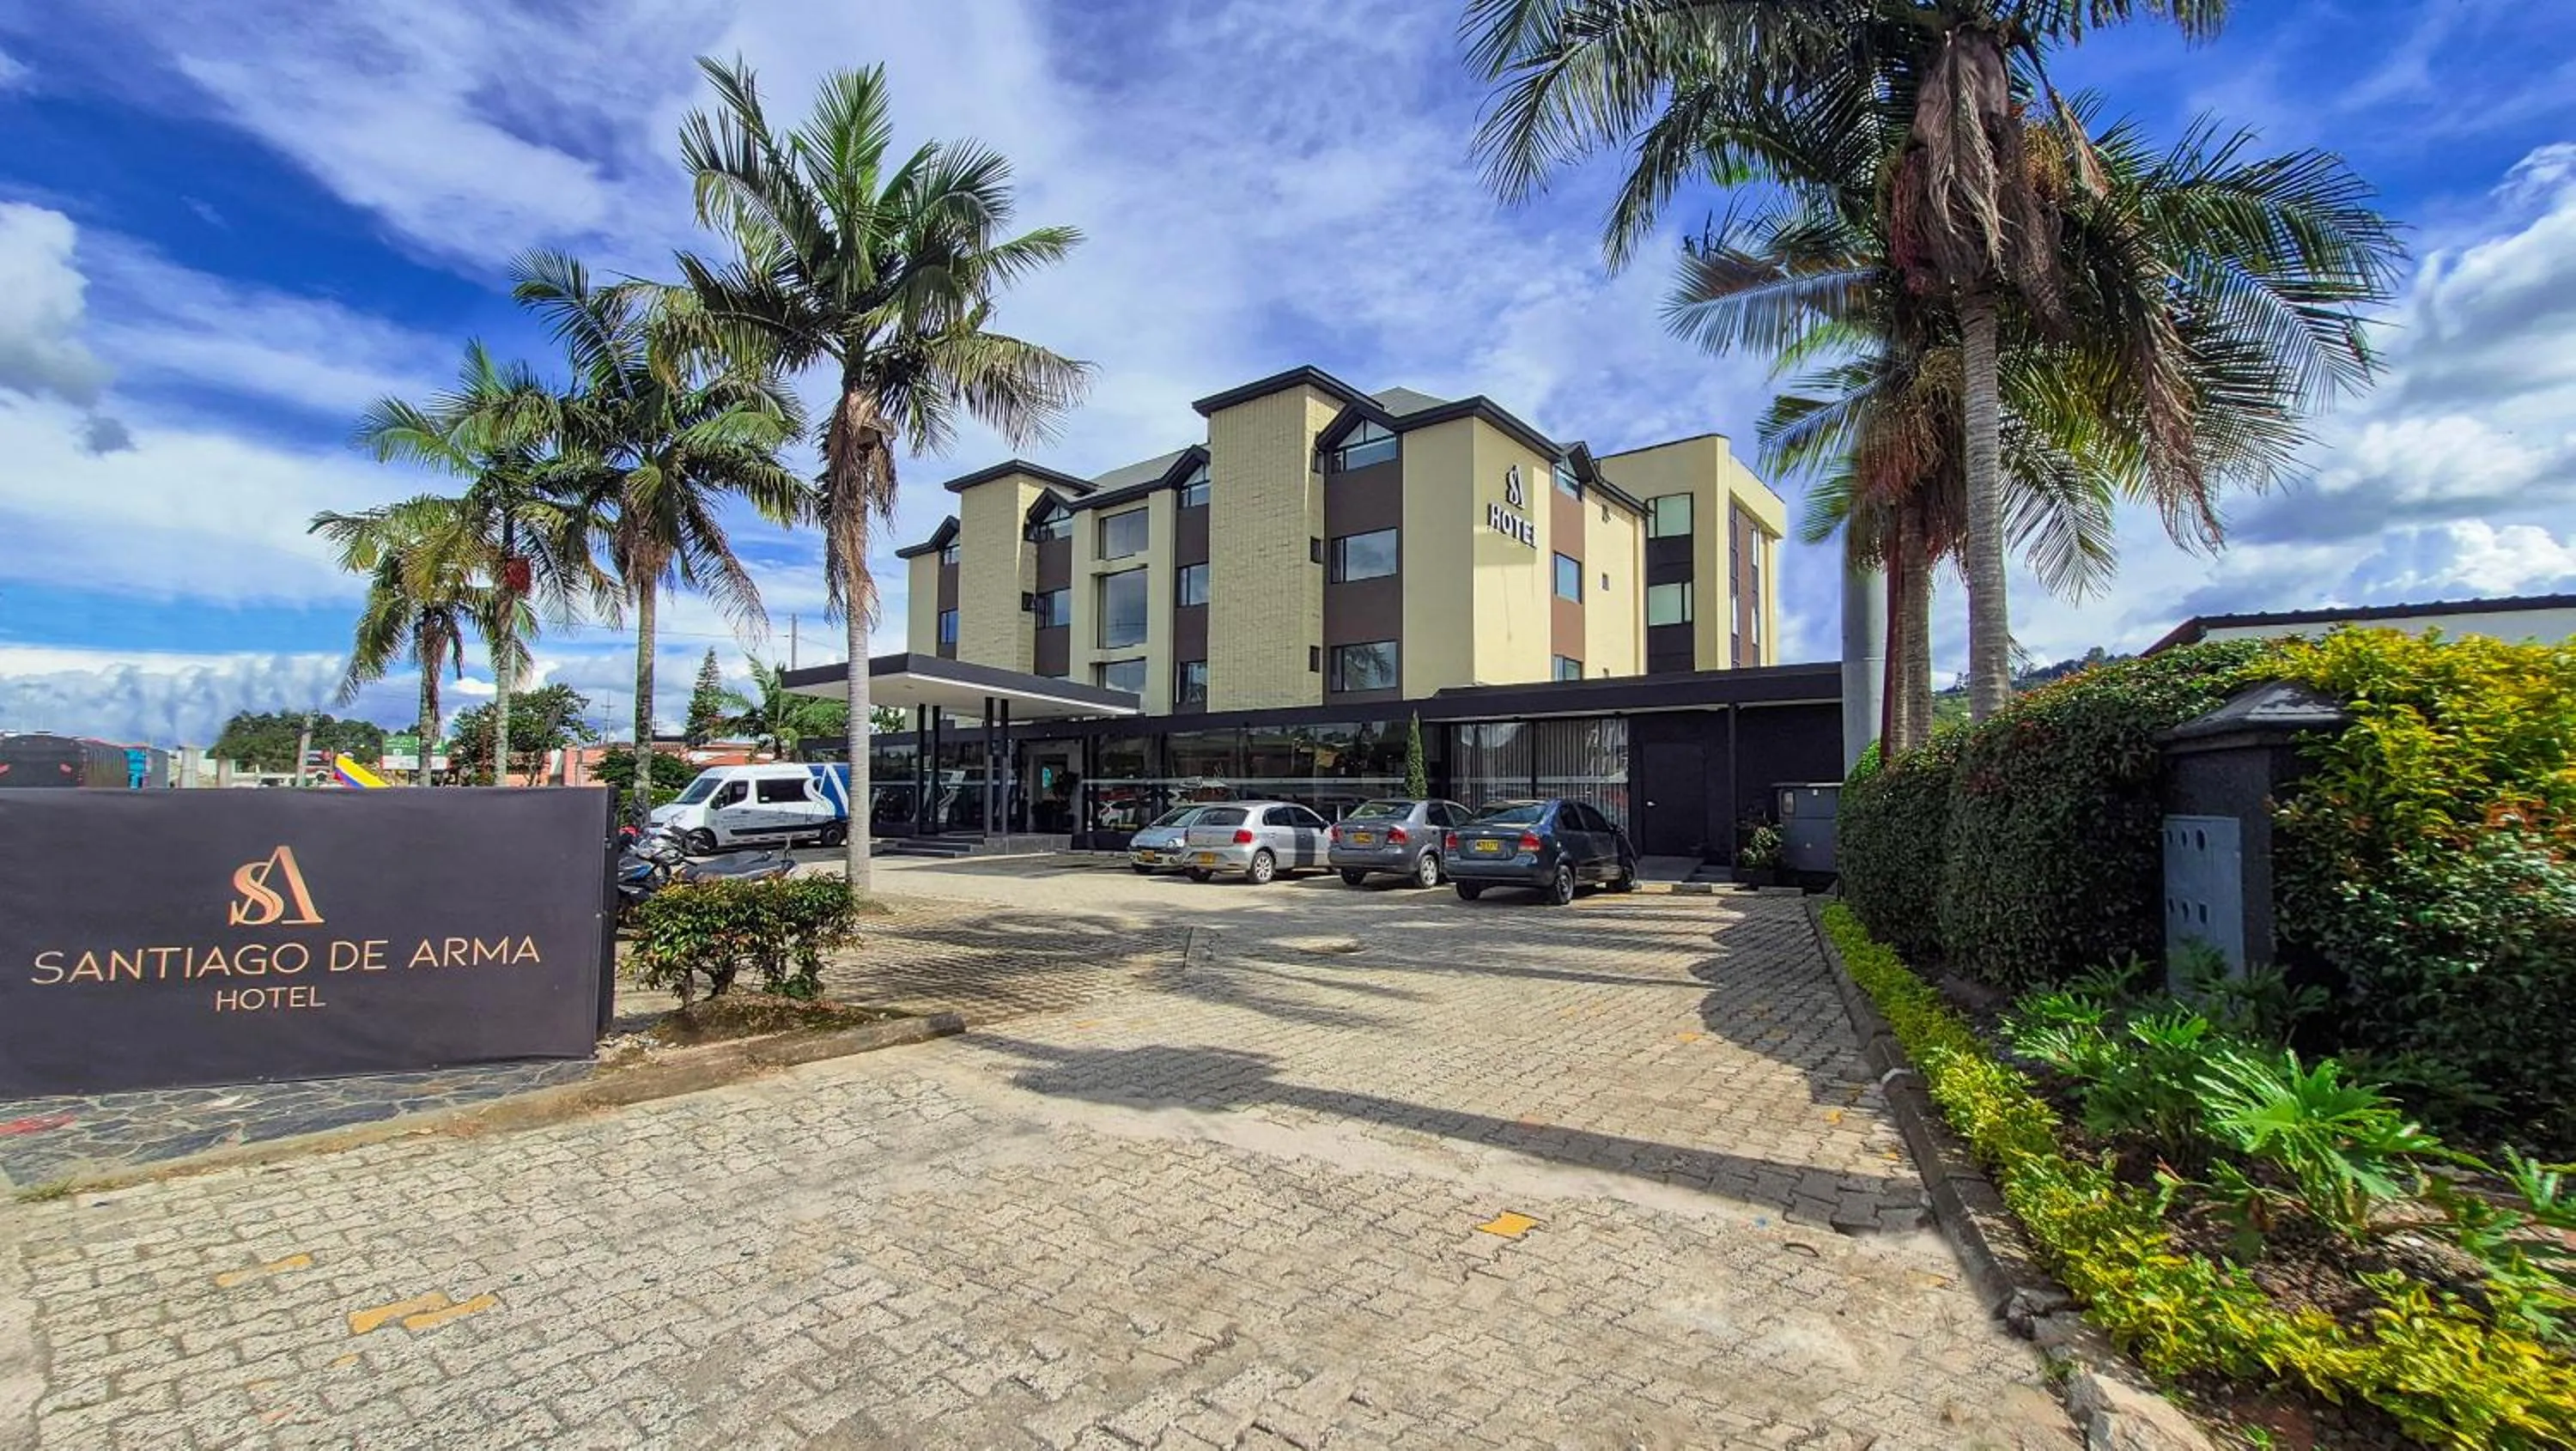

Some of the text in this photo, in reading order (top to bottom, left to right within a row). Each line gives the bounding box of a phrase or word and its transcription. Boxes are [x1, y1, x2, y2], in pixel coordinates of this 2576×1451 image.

[1487, 503, 1537, 549] HOTEL
[31, 935, 540, 985] SANTIAGO DE ARMA
[215, 985, 326, 1011] HOTEL
